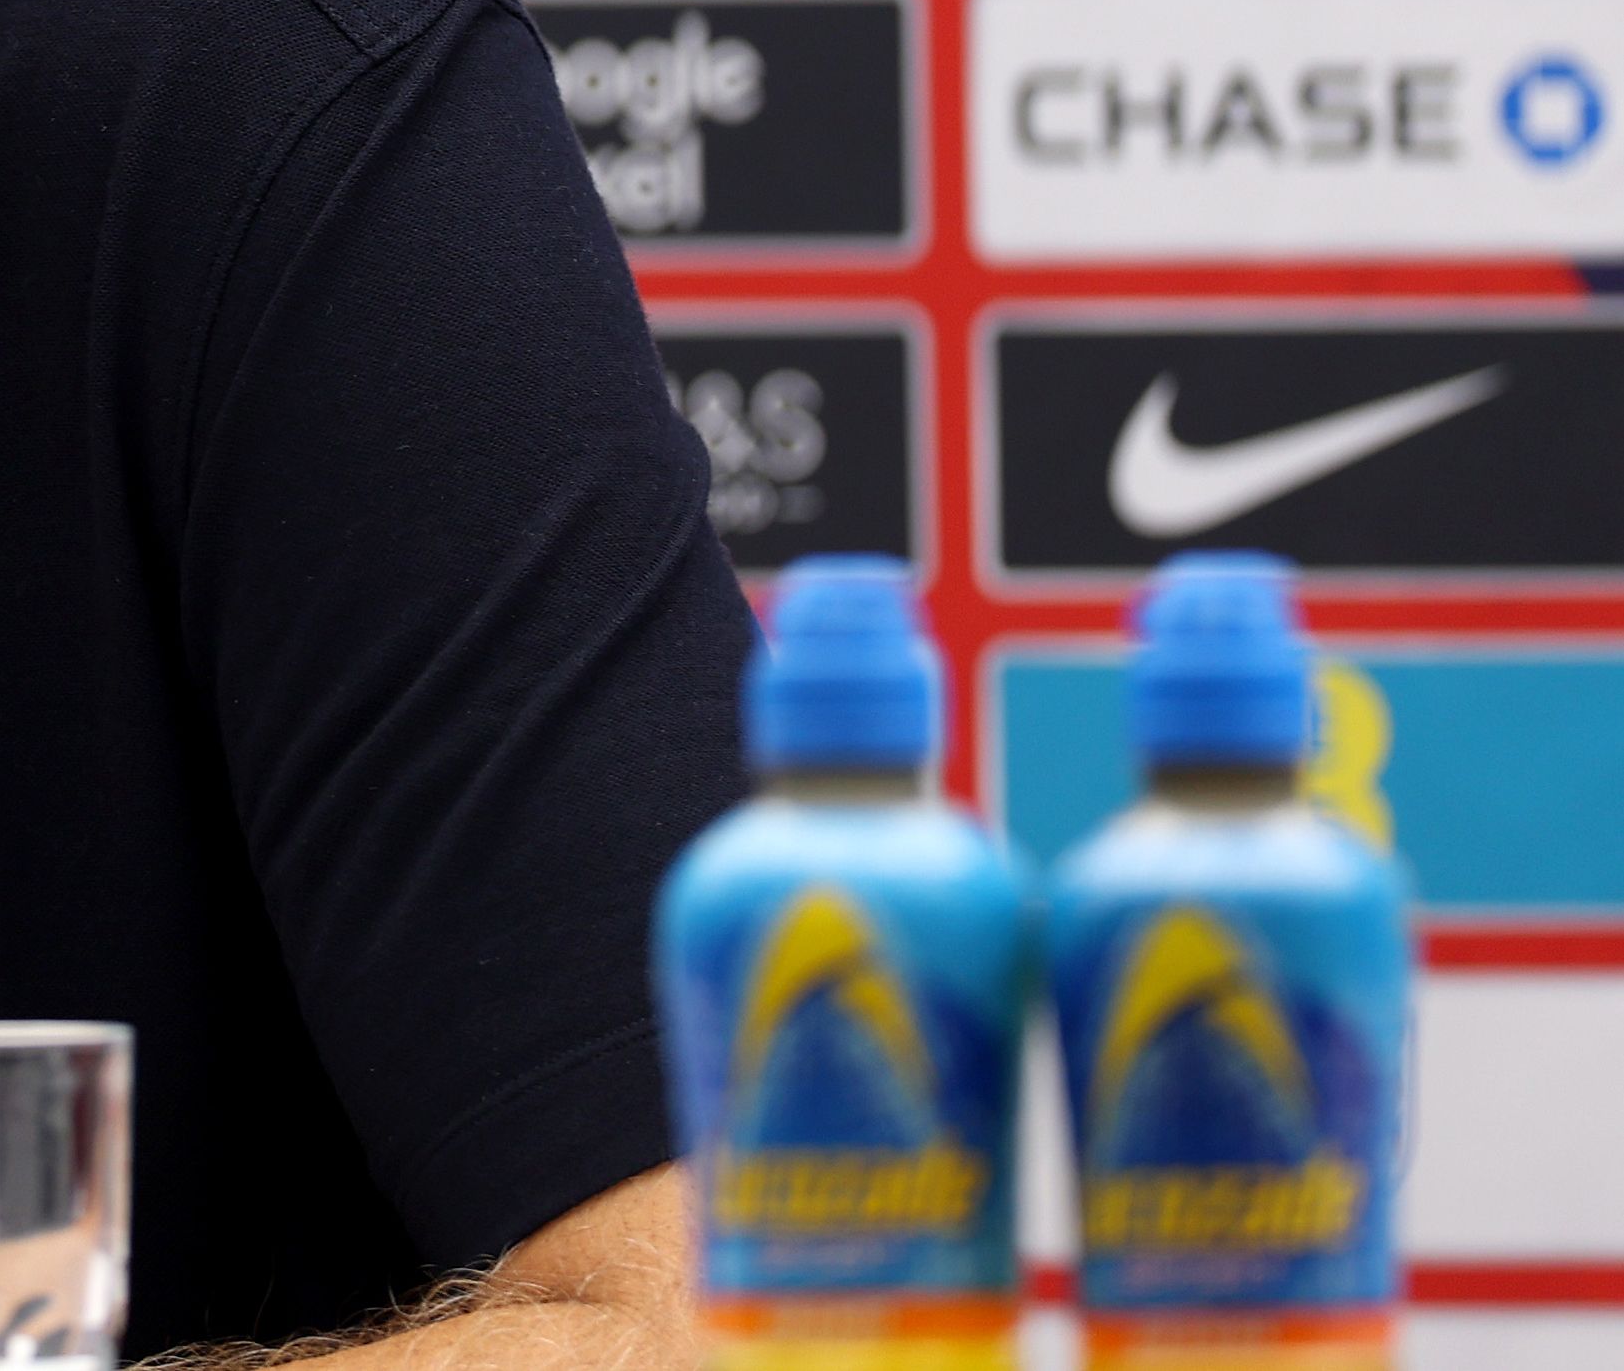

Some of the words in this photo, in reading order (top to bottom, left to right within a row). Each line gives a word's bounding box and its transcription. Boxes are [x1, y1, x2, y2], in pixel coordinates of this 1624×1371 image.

[553, 10, 765, 142] ogle
[1011, 61, 1464, 167] CHASE
[669, 366, 827, 485] &S
